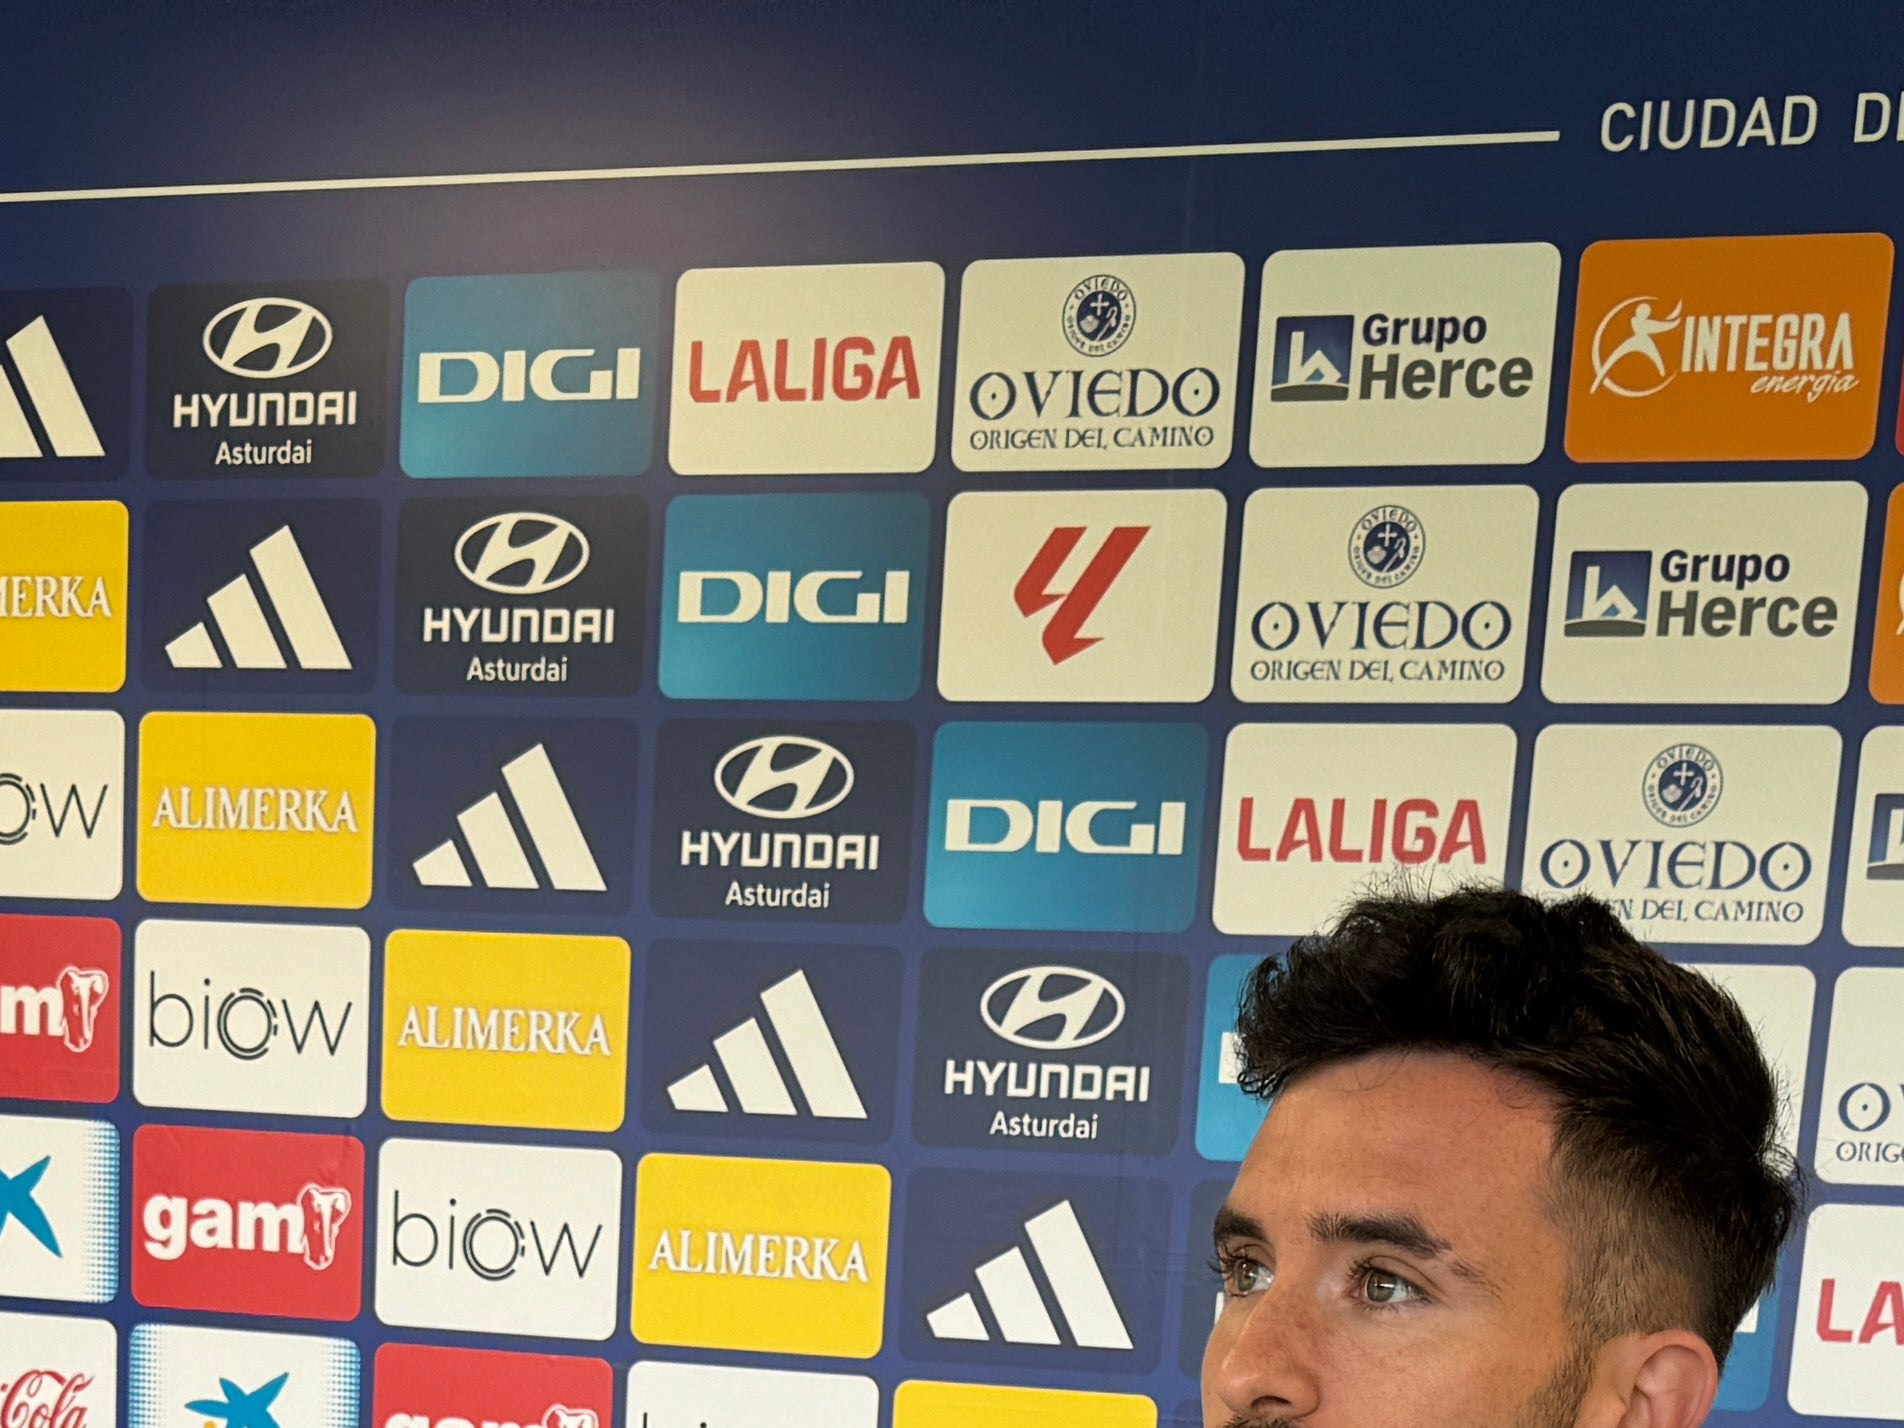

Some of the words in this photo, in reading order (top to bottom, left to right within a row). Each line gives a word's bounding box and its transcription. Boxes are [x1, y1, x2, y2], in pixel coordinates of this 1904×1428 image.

[1601, 95, 1817, 152] CIUDAD
[1364, 311, 1488, 347] Grupo
[1680, 311, 1855, 369] INTEGRA
[417, 349, 641, 402] DIGI
[689, 336, 921, 403] LALIGA
[971, 368, 1220, 418] OVIEDO
[1361, 352, 1533, 399] Herce
[172, 390, 356, 429] HYUNDAI
[214, 438, 312, 465] Asturdai
[970, 428, 1060, 450] ORIGEN
[1067, 428, 1108, 449] DEL
[1115, 427, 1214, 448] CAMINO
[1660, 549, 1789, 588] Grupo
[1251, 600, 1512, 652] OVIEDO
[1656, 589, 1838, 638] Herce
[152, 788, 358, 835] ALIMERKA
[945, 799, 1185, 855] DIGI
[1236, 797, 1487, 864] LALIGA
[679, 832, 878, 872] HYUNDAI
[1540, 837, 1812, 892] OVIEDO
[724, 881, 829, 907] Asturdai
[944, 1061, 1150, 1100] HYUNDAI
[989, 1112, 1097, 1138] Asturdai
[143, 1190, 304, 1259] gam
